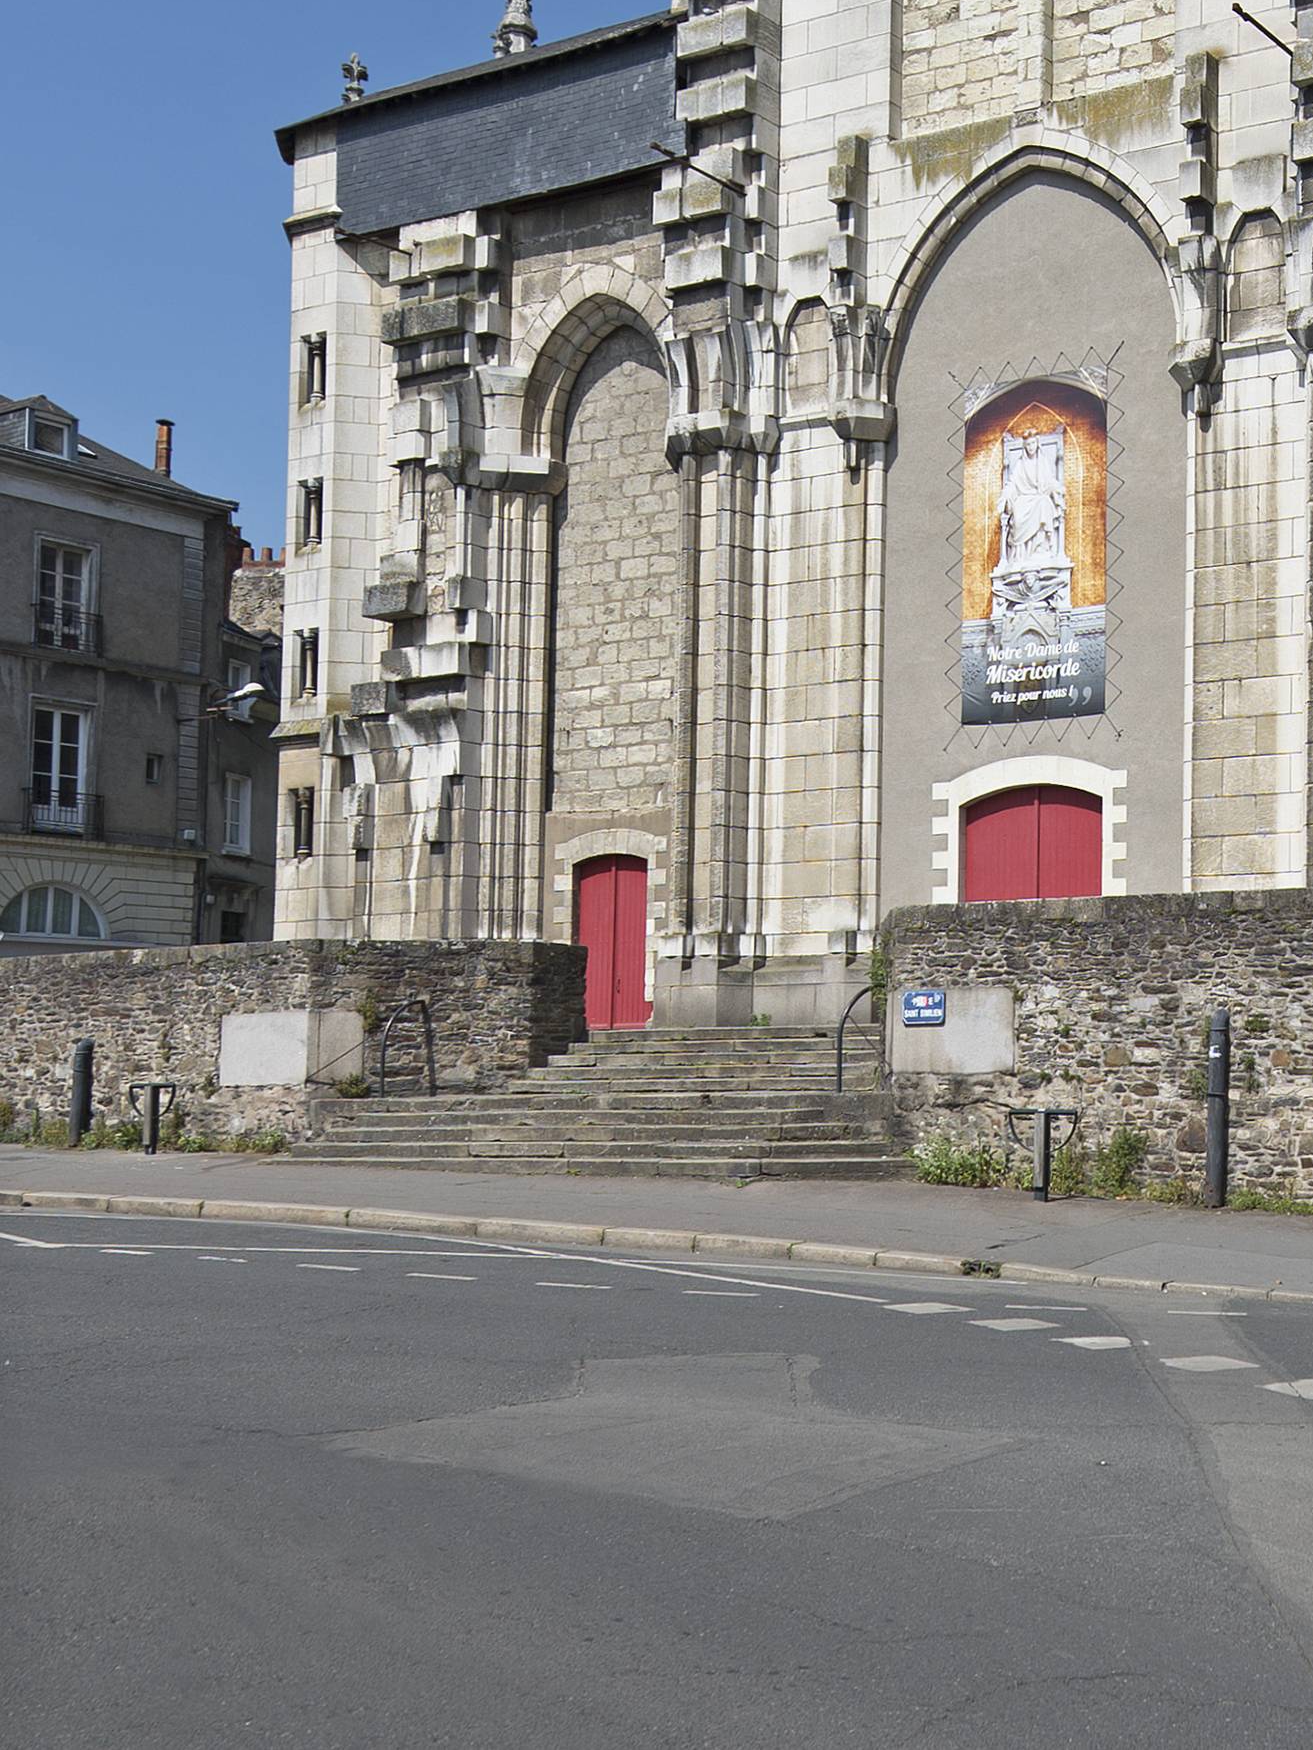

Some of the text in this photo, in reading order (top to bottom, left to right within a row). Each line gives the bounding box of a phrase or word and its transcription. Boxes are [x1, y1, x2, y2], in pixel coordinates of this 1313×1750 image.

[987, 639, 1080, 661] Notre Dame de
[986, 658, 1080, 684] Miséricorde
[991, 691, 1017, 704] Priez
[1017, 690, 1042, 705] pour
[1042, 686, 1067, 699] nous
